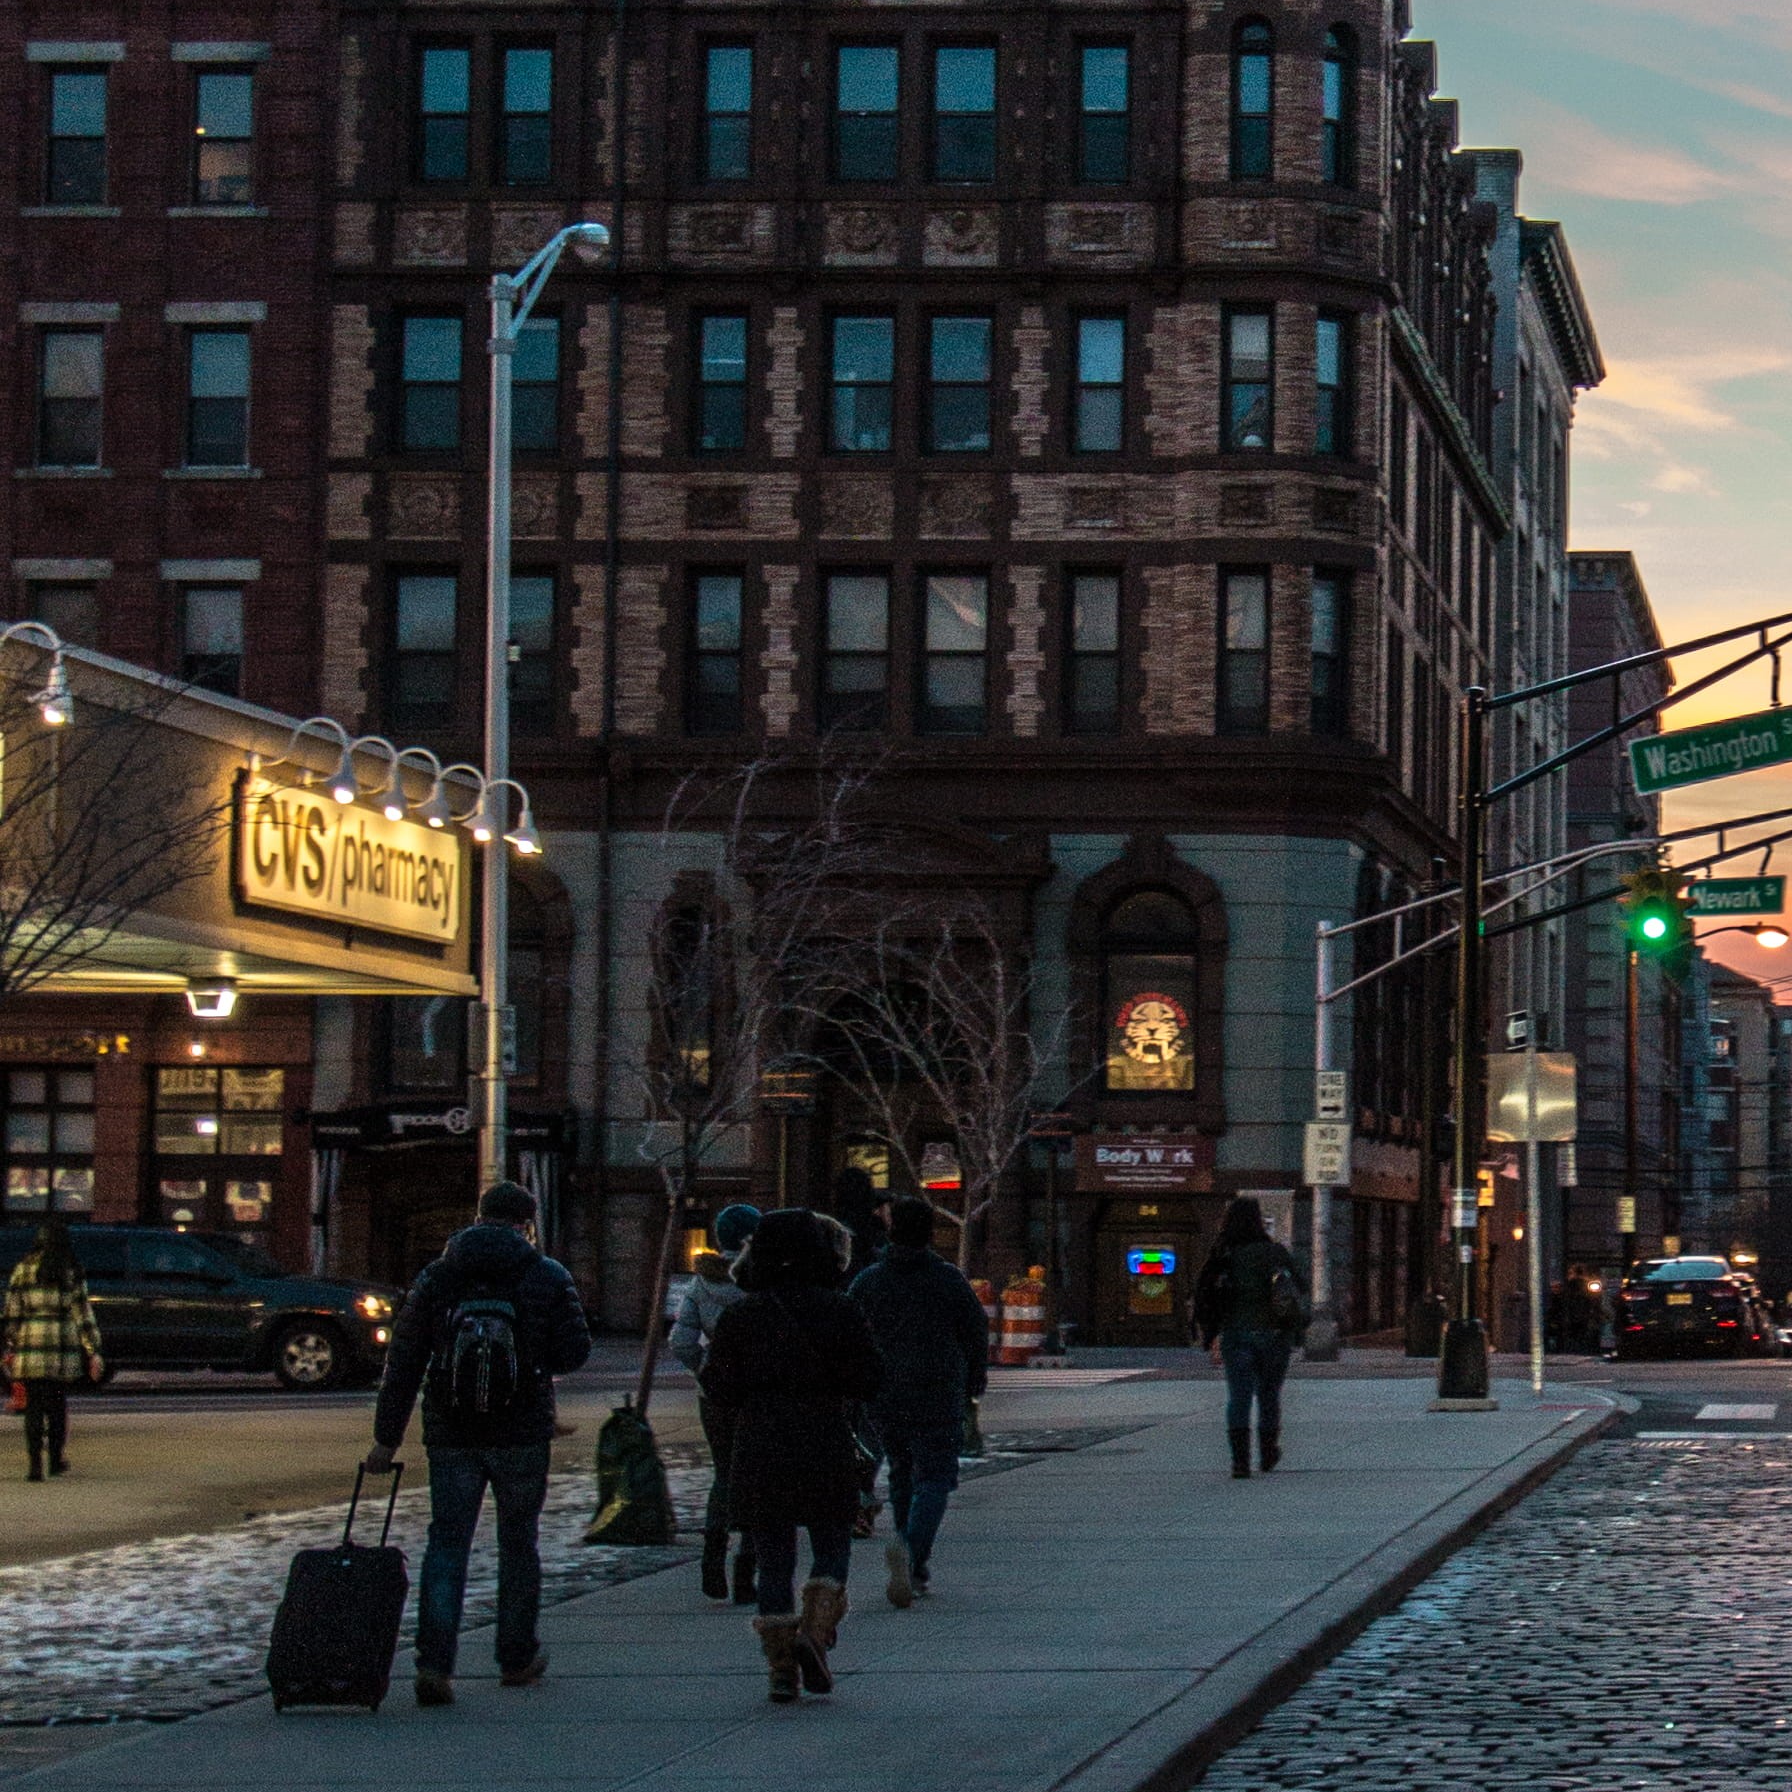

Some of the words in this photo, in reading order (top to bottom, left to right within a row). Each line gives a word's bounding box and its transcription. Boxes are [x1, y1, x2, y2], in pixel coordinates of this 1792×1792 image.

[1644, 730, 1778, 780] Washington
[1692, 885, 1761, 910] Newark
[1765, 883, 1777, 896] St
[1320, 1074, 1345, 1086] ONE
[1318, 1128, 1339, 1140] NO
[1096, 1148, 1142, 1165] Body
[1144, 1149, 1195, 1163] Wrk
